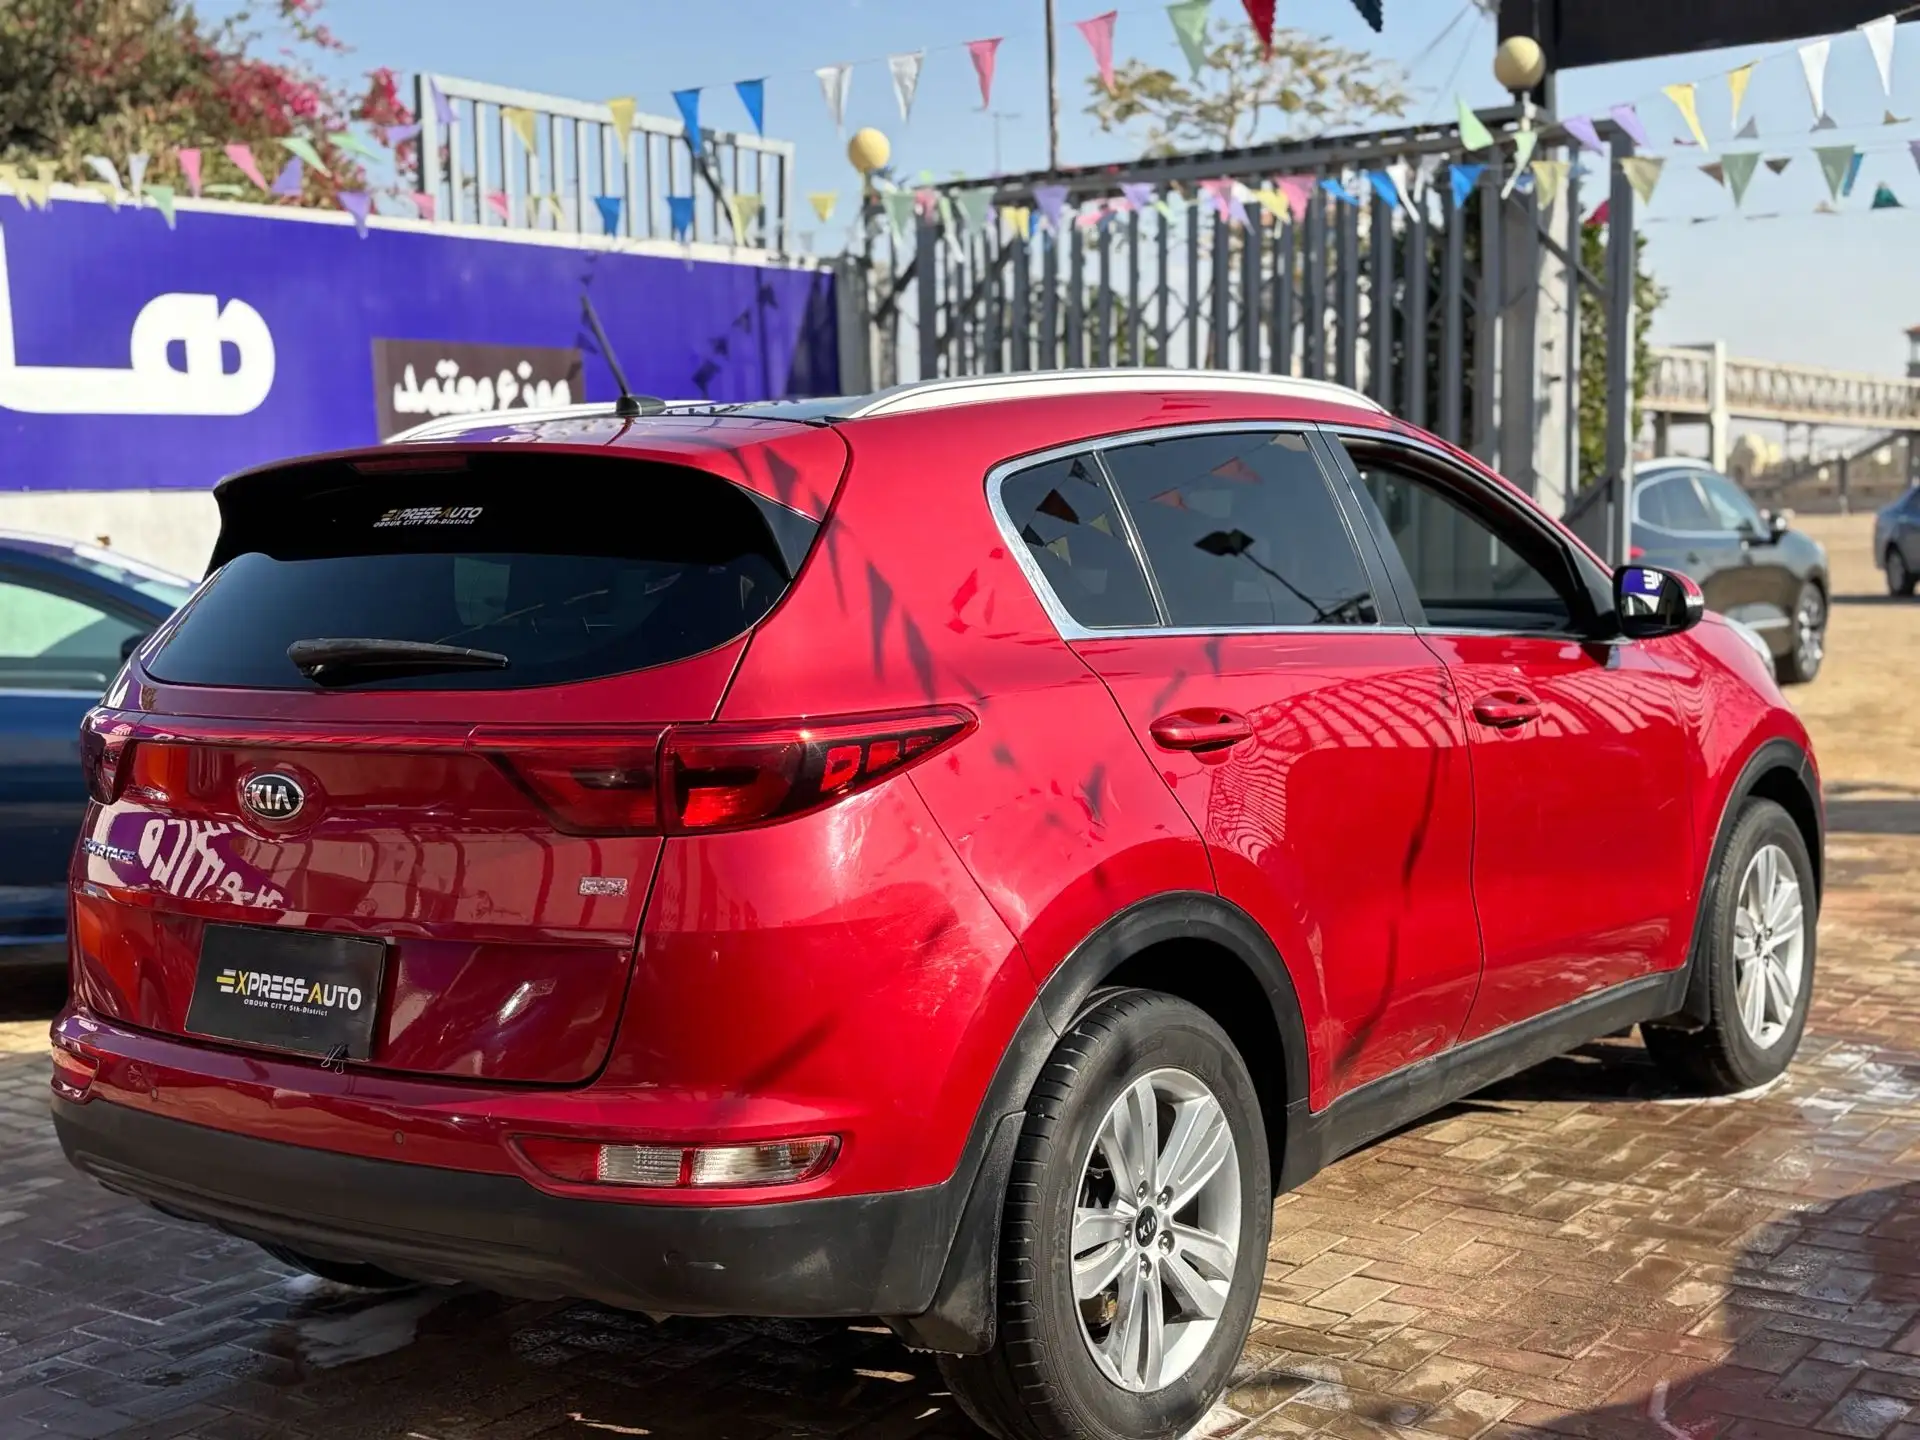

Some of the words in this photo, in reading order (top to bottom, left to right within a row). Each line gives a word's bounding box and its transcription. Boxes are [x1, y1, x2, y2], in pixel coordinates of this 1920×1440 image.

[394, 359, 495, 416] معتمد
[250, 784, 292, 810] KIA
[243, 998, 269, 1008] OBOUR
[270, 1002, 287, 1011] CITY
[307, 982, 362, 1011] AUTO
[1139, 1216, 1157, 1239] KIA
